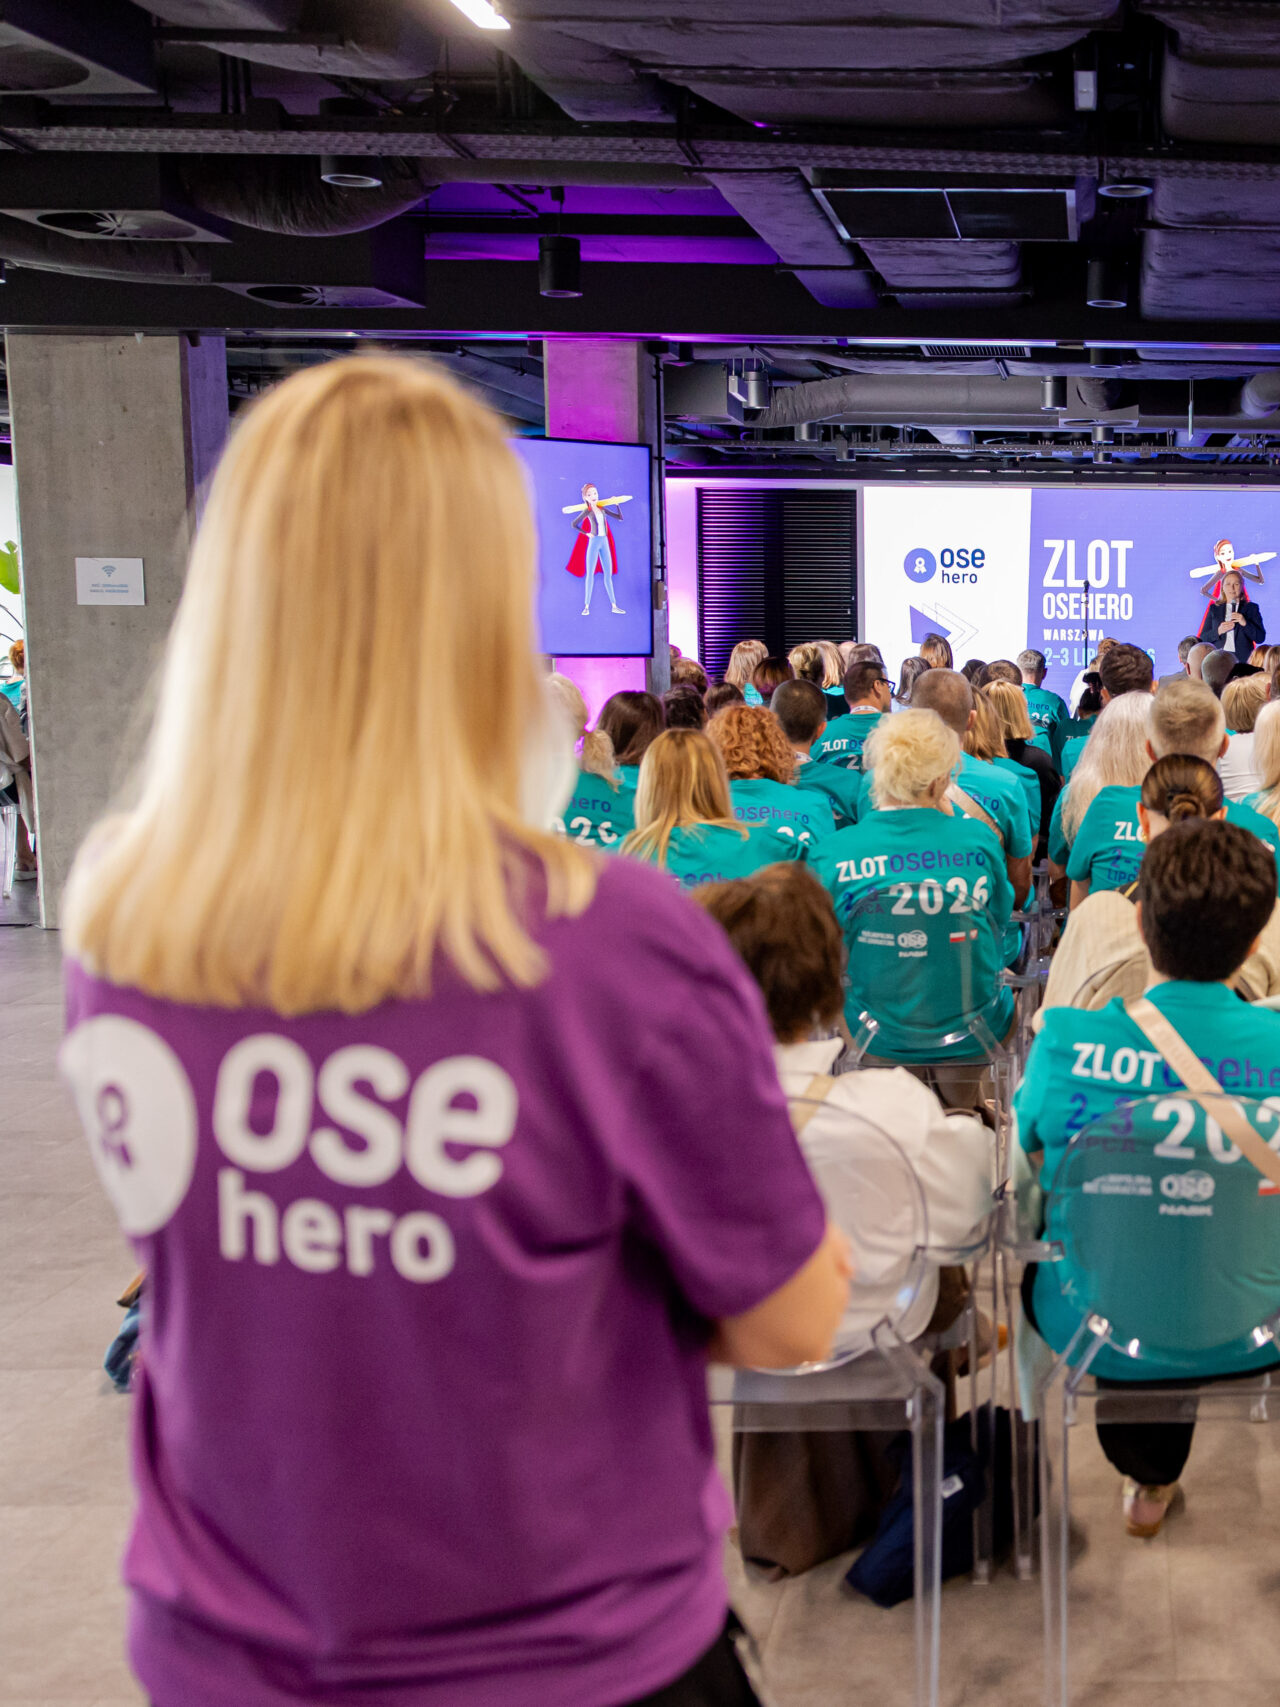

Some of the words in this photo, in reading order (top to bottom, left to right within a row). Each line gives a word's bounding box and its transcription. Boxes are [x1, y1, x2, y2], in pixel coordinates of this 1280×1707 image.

[940, 548, 985, 569] ose
[941, 570, 978, 584] hero
[1042, 539, 1134, 589] ZLOT
[1042, 592, 1133, 620] OSEHERO
[889, 875, 989, 916] 2026
[211, 1032, 520, 1199] ose
[217, 1165, 456, 1285] hero
